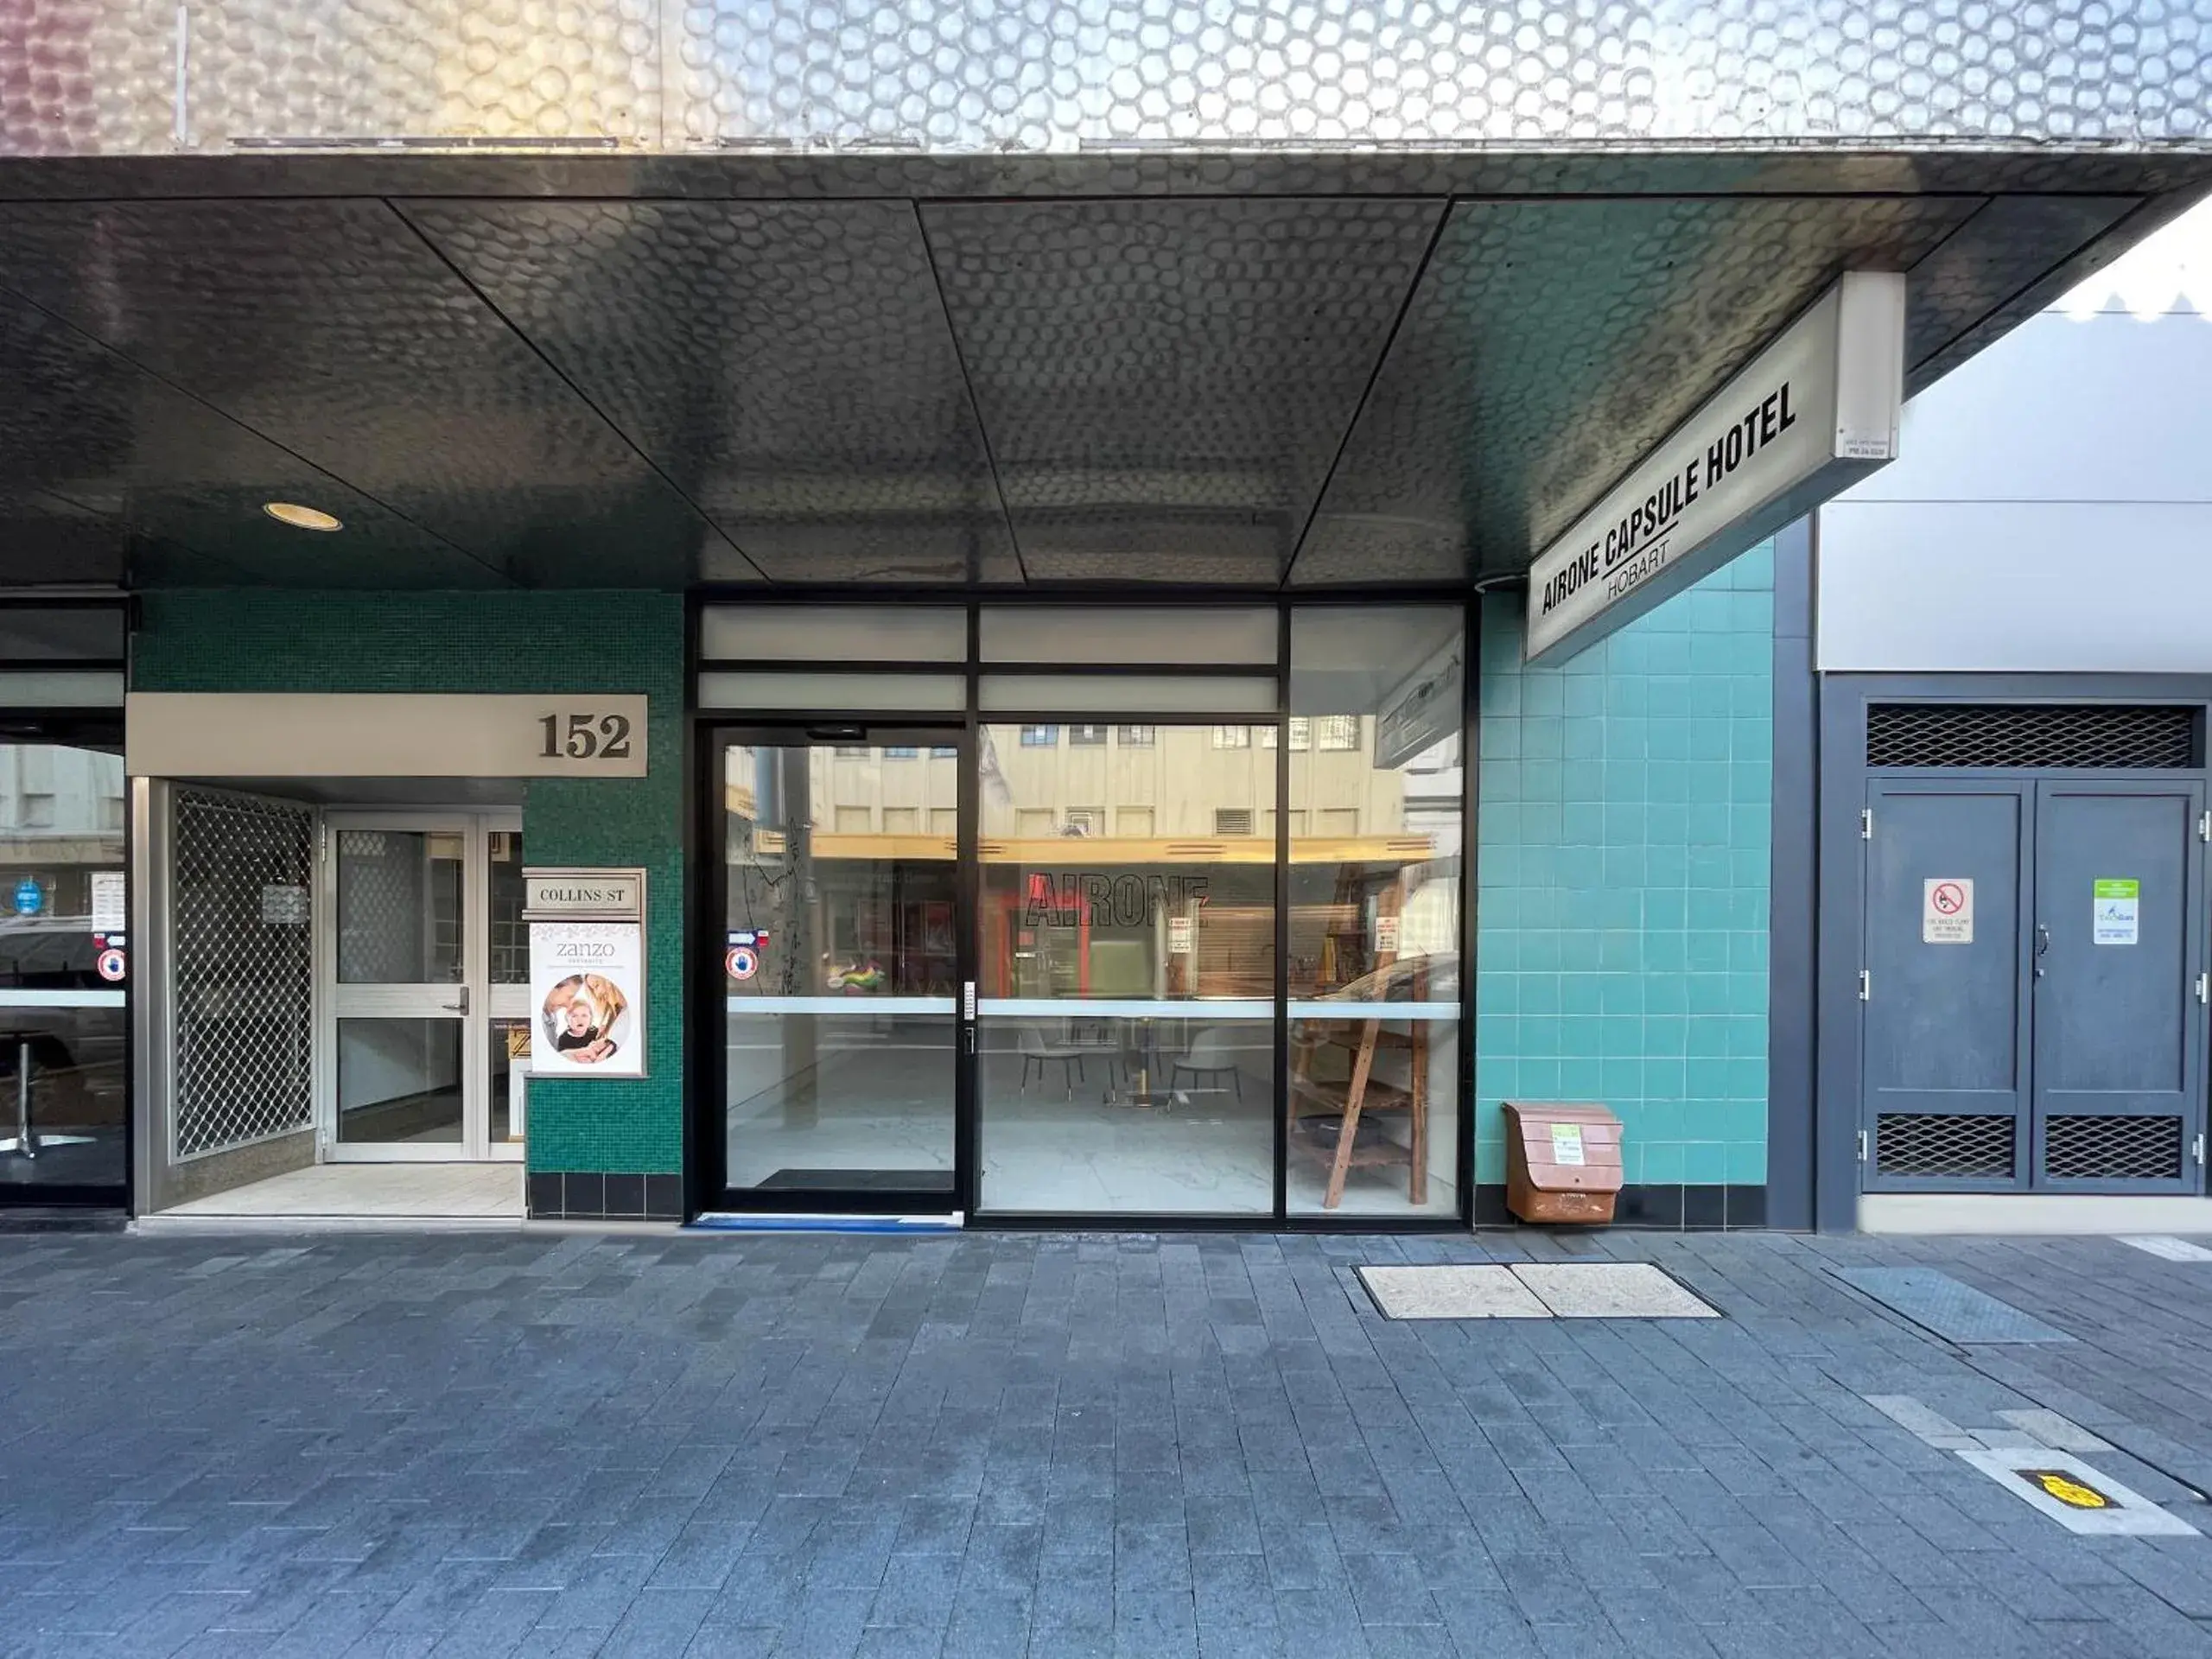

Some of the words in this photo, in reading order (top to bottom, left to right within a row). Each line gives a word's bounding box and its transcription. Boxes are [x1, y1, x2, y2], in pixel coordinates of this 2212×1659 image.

[1542, 542, 1599, 616] AIRONE
[1605, 458, 1699, 567] CAPSULE
[1707, 381, 1796, 490] HOTEL
[1607, 539, 1669, 600] HOBART
[538, 714, 630, 759] 152
[540, 888, 602, 901] COLLINS
[607, 889, 625, 901] ST
[1026, 873, 1208, 927] AIRONE
[556, 943, 615, 957] zanzo
